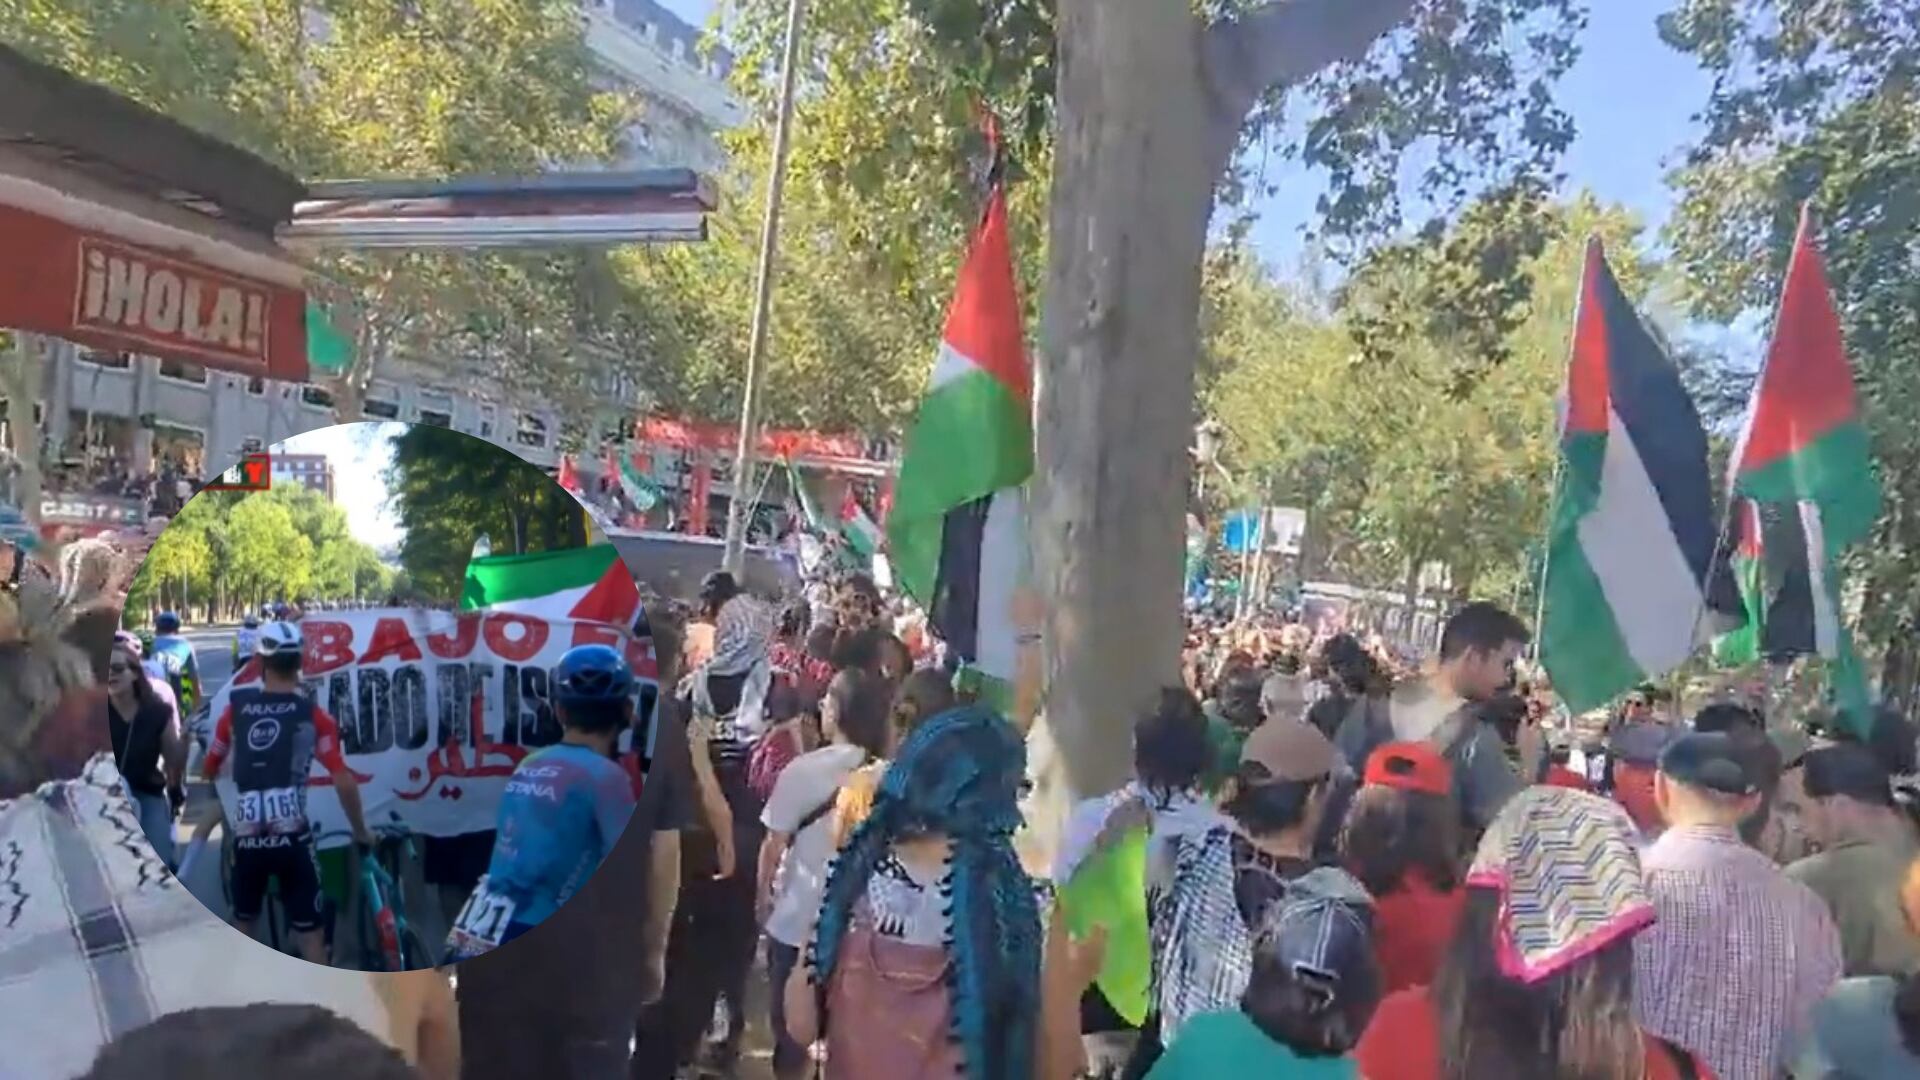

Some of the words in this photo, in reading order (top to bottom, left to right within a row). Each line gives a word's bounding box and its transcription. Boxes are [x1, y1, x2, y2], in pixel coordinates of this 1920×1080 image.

[85, 249, 263, 350] ¡HOLA!
[241, 702, 297, 716] ARKEA
[238, 835, 292, 850] ARKEA
